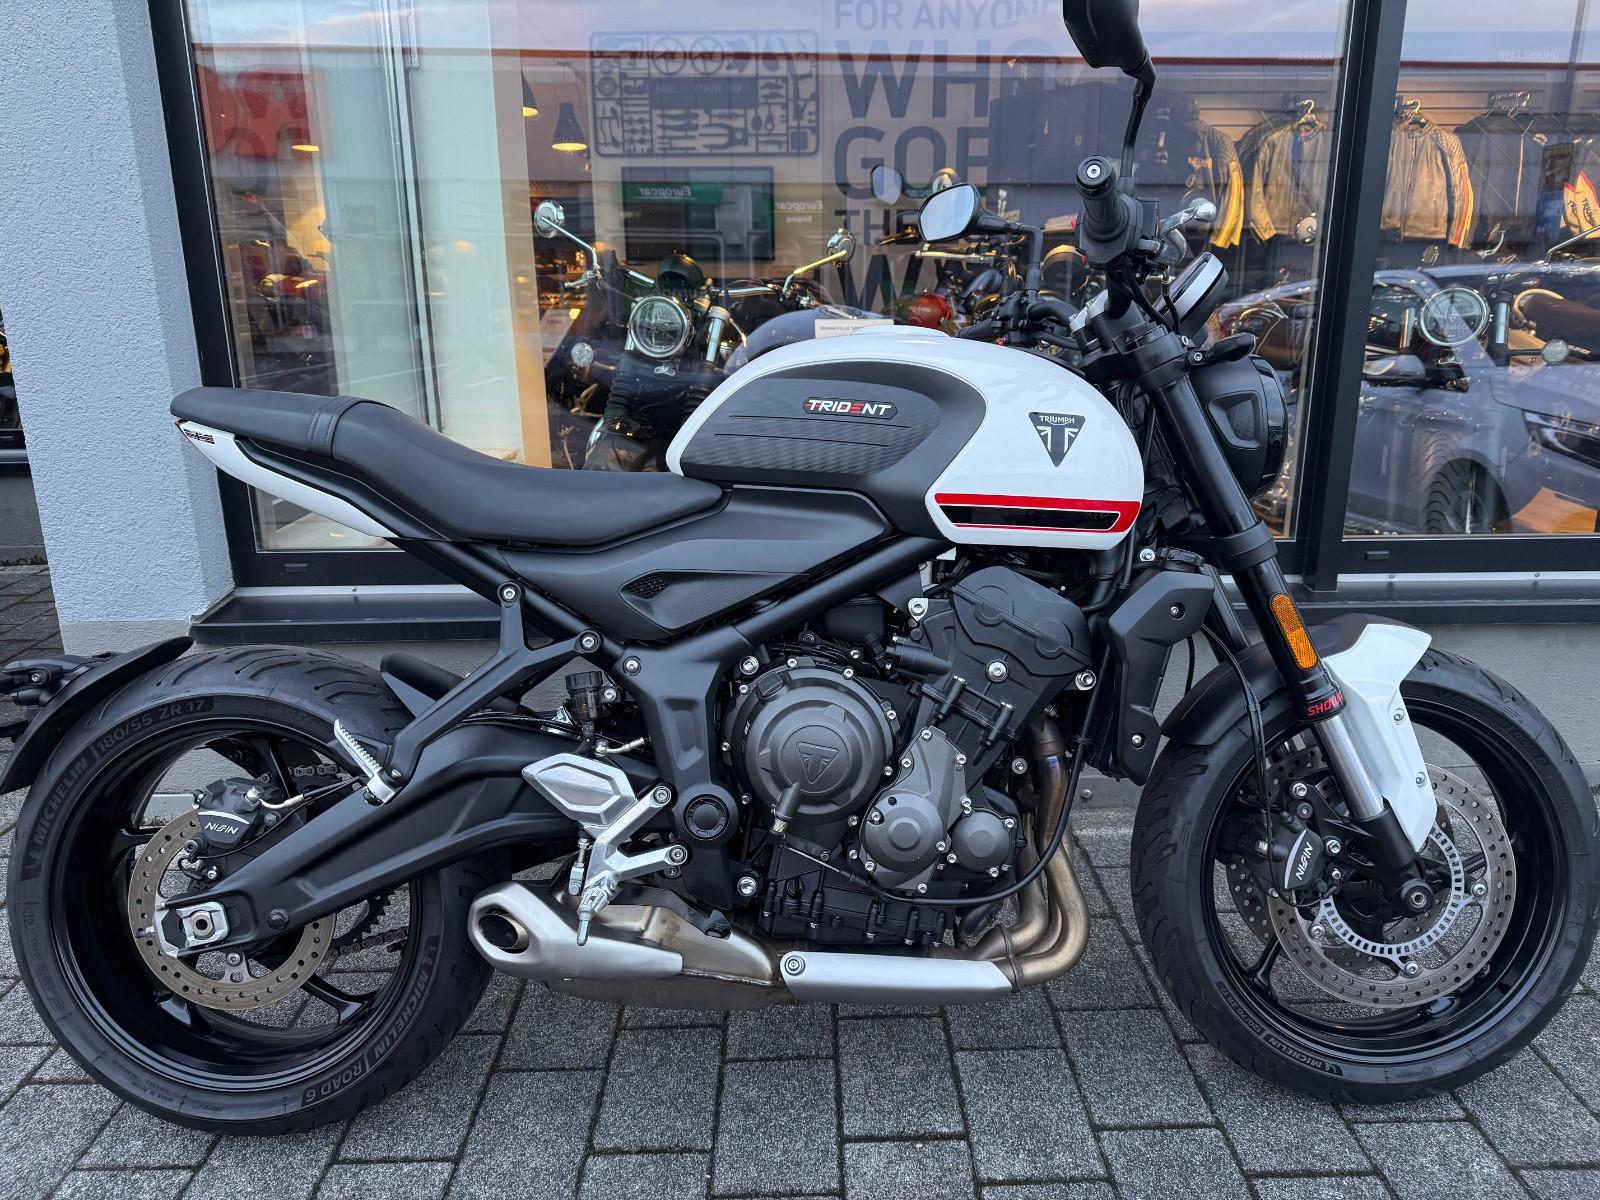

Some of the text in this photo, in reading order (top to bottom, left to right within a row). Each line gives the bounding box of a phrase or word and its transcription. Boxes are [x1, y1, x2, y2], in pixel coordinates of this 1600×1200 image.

[835, 0, 903, 30] FOR
[807, 399, 892, 416] TRIDENT
[1039, 415, 1075, 426] TRIUMPH
[33, 757, 89, 845] MICHELIN
[96, 713, 153, 752] 180/55
[158, 705, 182, 720] ZR
[205, 821, 239, 835] NISSIN
[1295, 842, 1314, 881] NISSIN
[374, 974, 429, 1060] MICHELIN
[1268, 1037, 1321, 1069] MICHELIN
[320, 1063, 362, 1096] ROAD
